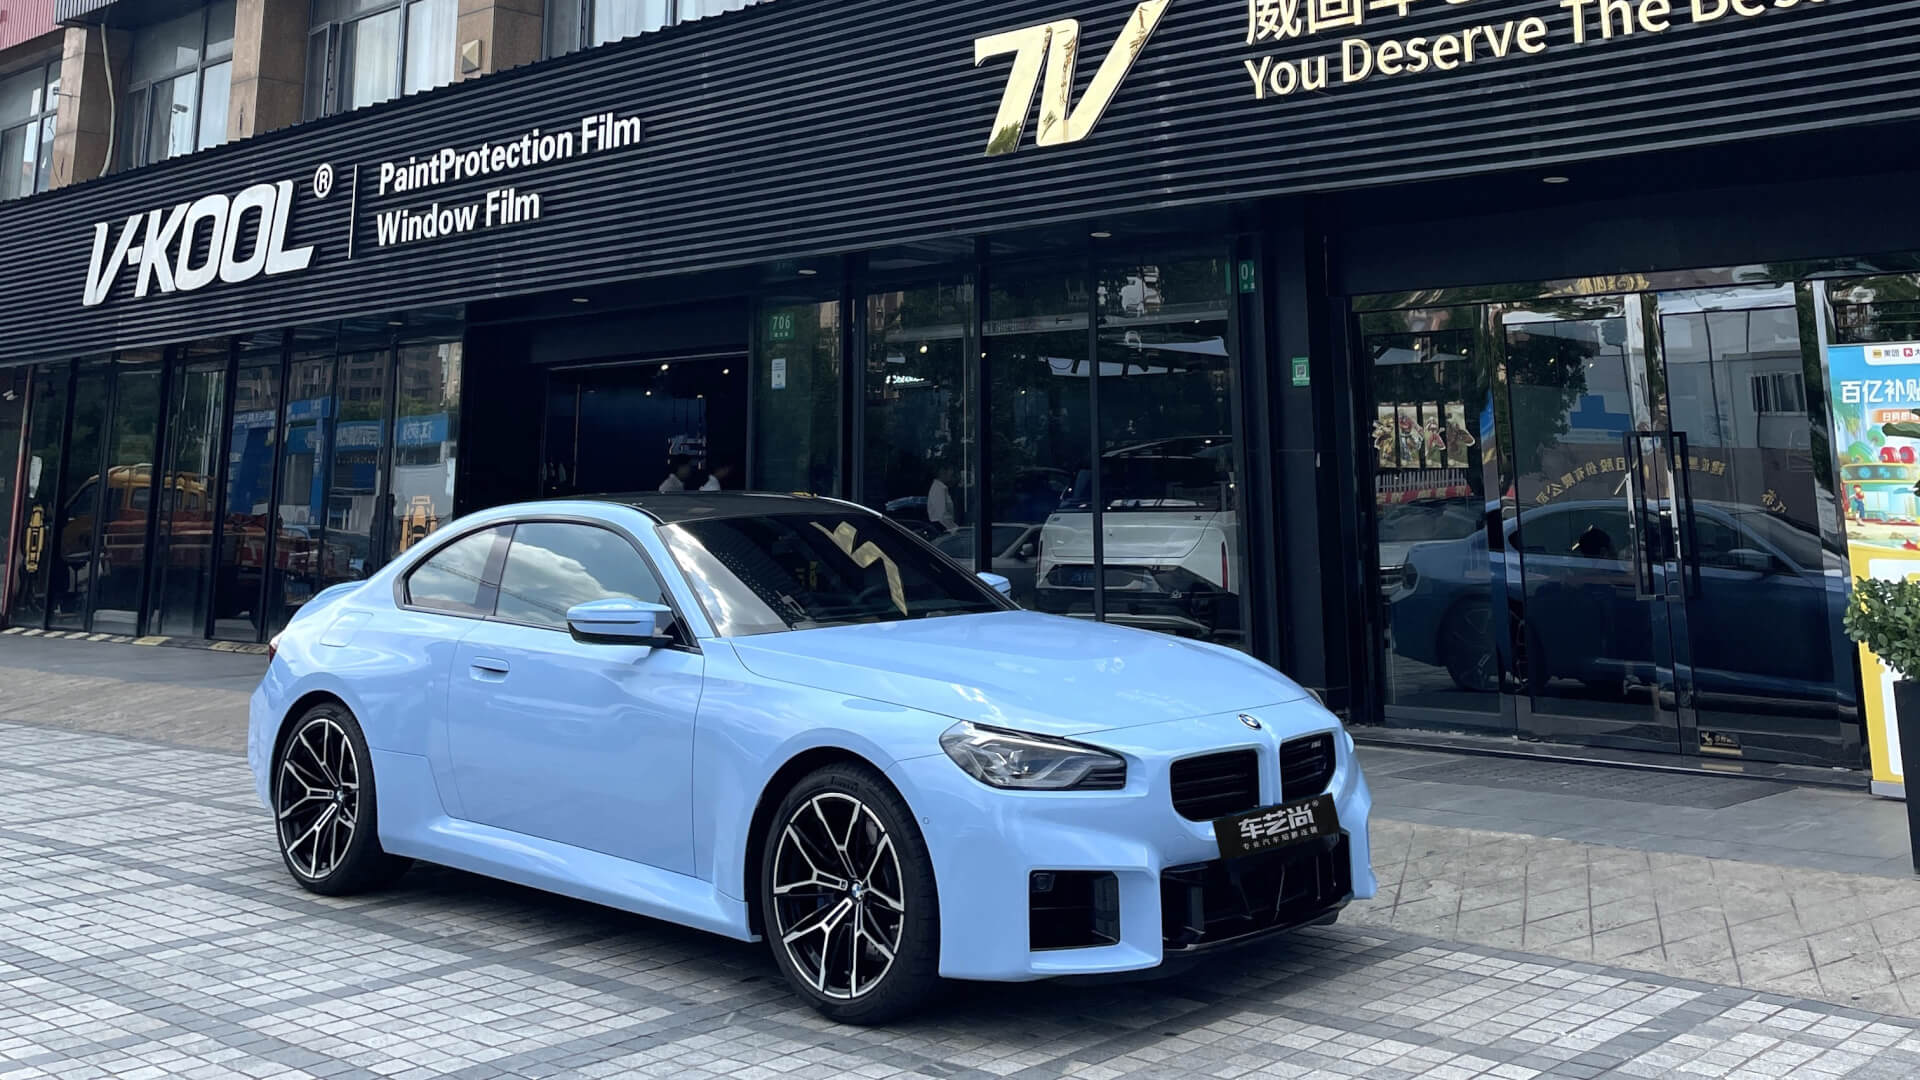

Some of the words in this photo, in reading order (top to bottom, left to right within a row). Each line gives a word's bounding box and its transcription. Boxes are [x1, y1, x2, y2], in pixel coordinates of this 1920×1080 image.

[1244, 56, 1327, 99] You
[1342, 17, 1547, 83] Deserve
[1560, 0, 1671, 44] The
[379, 128, 573, 195] PaintProtection
[581, 112, 641, 154] Film
[83, 179, 314, 306] V-KOOL
[376, 202, 478, 246] Window
[485, 188, 540, 227] Film
[772, 315, 791, 330] 706
[1841, 378, 1920, 404] 百亿补贴
[1238, 803, 1314, 839] 车艺尚
